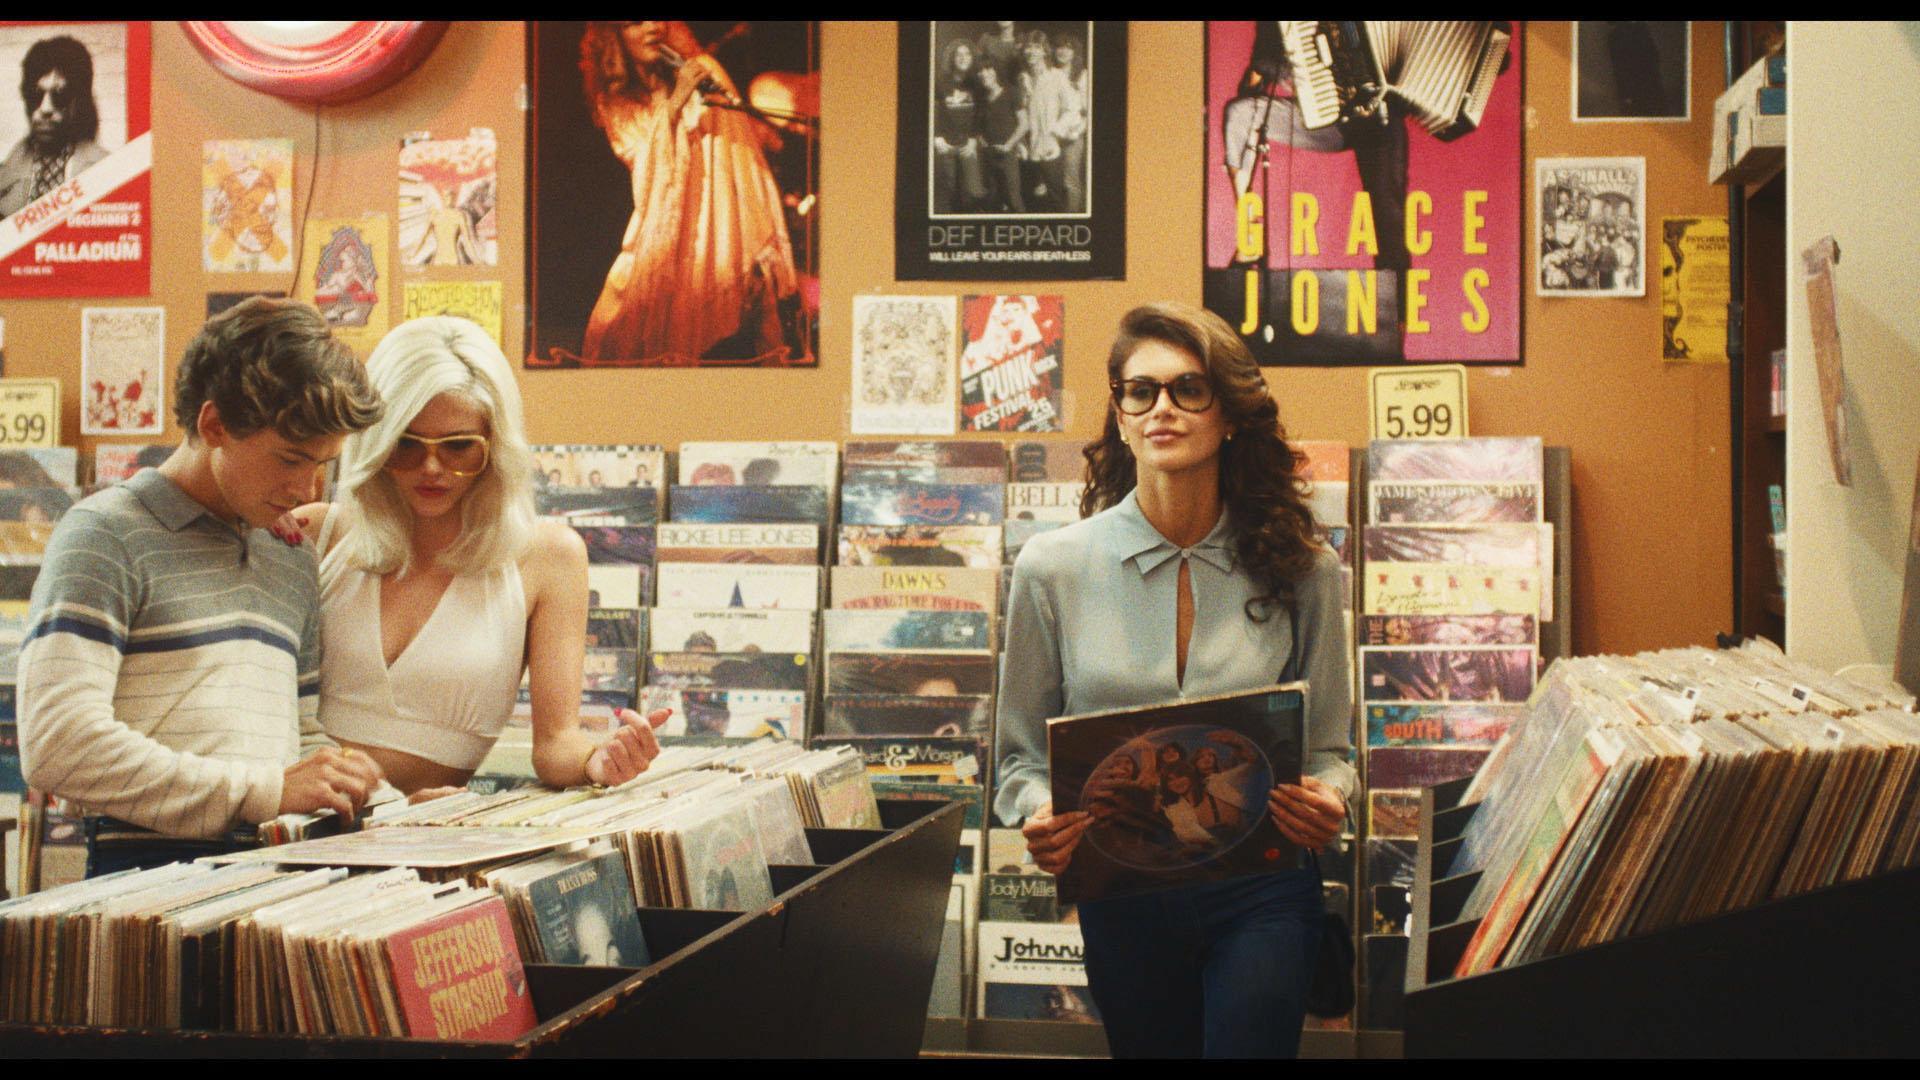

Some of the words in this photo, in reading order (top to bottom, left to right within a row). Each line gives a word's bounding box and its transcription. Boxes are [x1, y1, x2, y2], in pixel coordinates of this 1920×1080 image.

[15, 180, 84, 232] PRINCE
[131, 213, 141, 227] 2
[928, 226, 975, 246] DEF
[980, 225, 1092, 246] LEPPARD
[1236, 191, 1489, 257] GRACE
[35, 241, 141, 263] PALLADIUM
[929, 252, 950, 262] WILL
[951, 252, 980, 262] LEAVE
[981, 251, 1007, 262] YOUR
[1008, 251, 1032, 262] EARS
[1033, 251, 1091, 262] BREATHLESS
[1240, 268, 1490, 336] JONES
[980, 349, 1039, 409] PUNK
[974, 392, 1034, 431] FESTIVAL
[1386, 403, 1453, 439] 5.99
[1011, 485, 1067, 508] BELL
[660, 527, 712, 546] RICKIE
[718, 528, 749, 546] LEE
[754, 527, 813, 546] JONES
[1383, 716, 1444, 742] SOUTH
[885, 744, 916, 771] &
[410, 913, 502, 990] JEFFERSON
[428, 967, 510, 1041] STARSHIP
